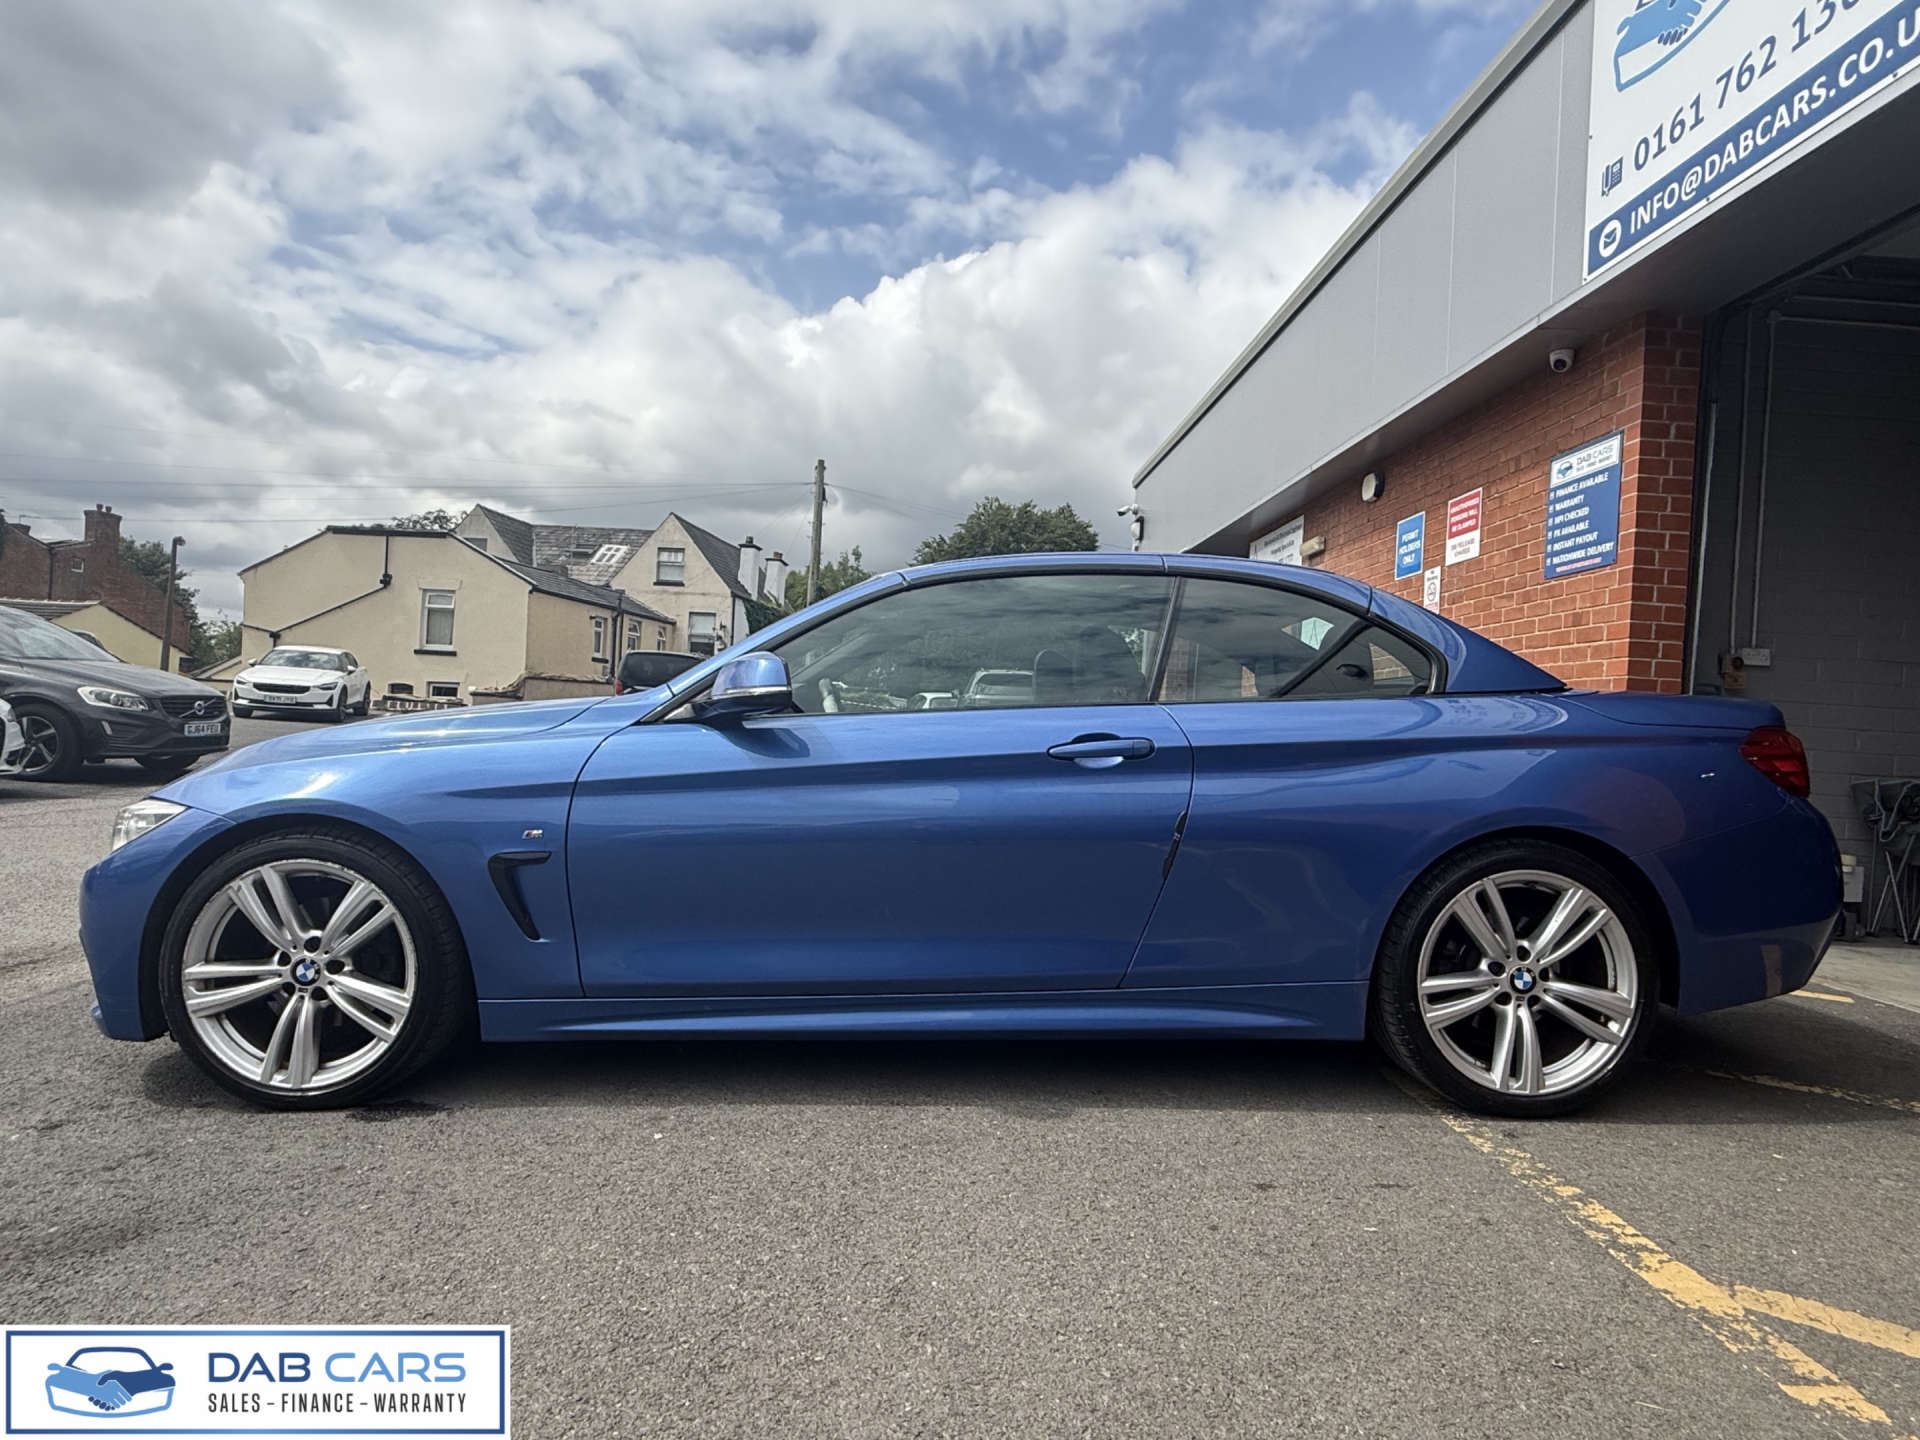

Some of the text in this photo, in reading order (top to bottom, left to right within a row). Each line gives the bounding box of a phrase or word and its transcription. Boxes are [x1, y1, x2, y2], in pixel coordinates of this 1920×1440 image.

[1633, 0, 1859, 171] 0161 762 13
